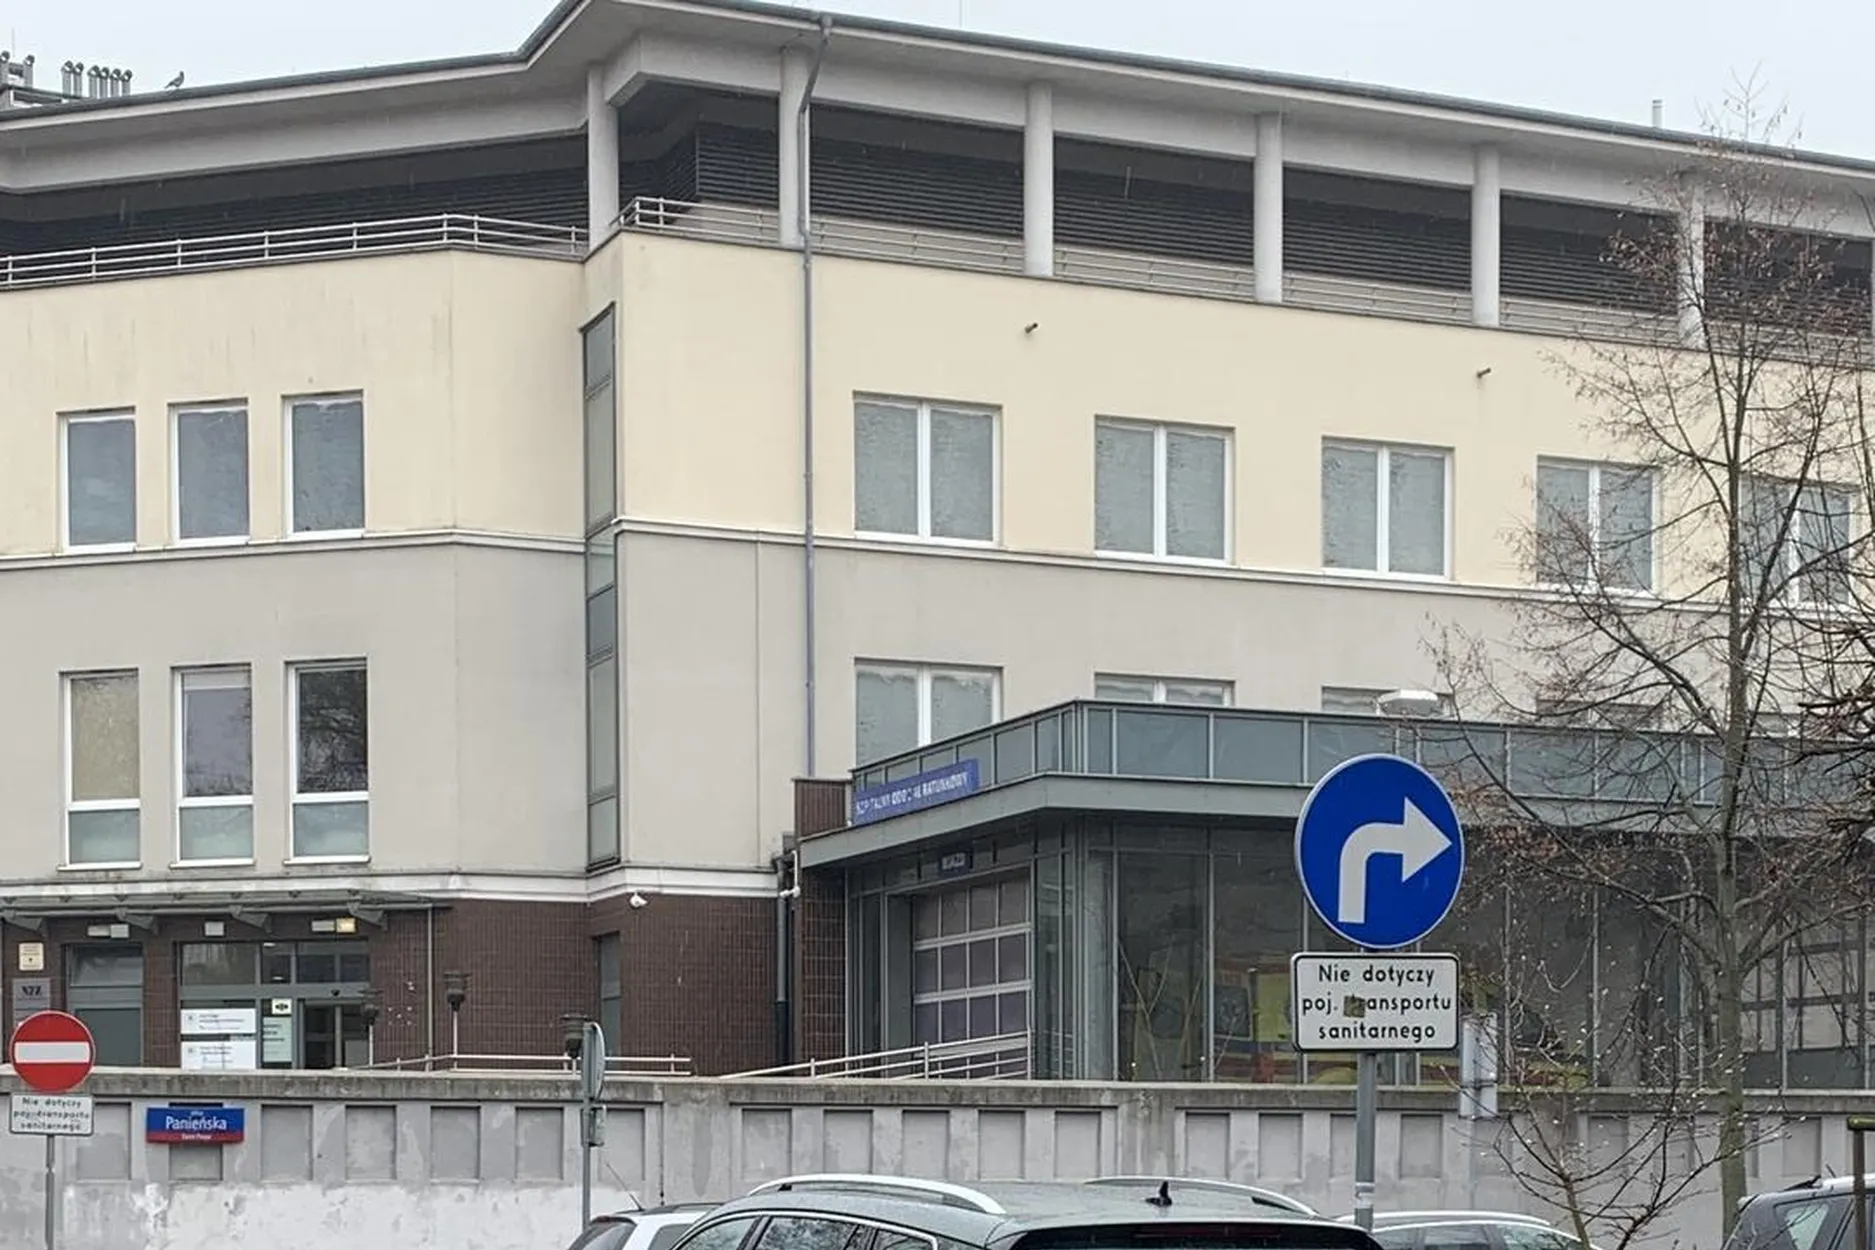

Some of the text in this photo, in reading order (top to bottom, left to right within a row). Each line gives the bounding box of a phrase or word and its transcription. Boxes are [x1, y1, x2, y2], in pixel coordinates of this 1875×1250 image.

[1318, 964, 1436, 987] Nie dotyczy
[1302, 991, 1452, 1015] poj. ansportu
[1318, 1021, 1437, 1043] sanitarnego
[165, 1115, 228, 1131] Panieńska
